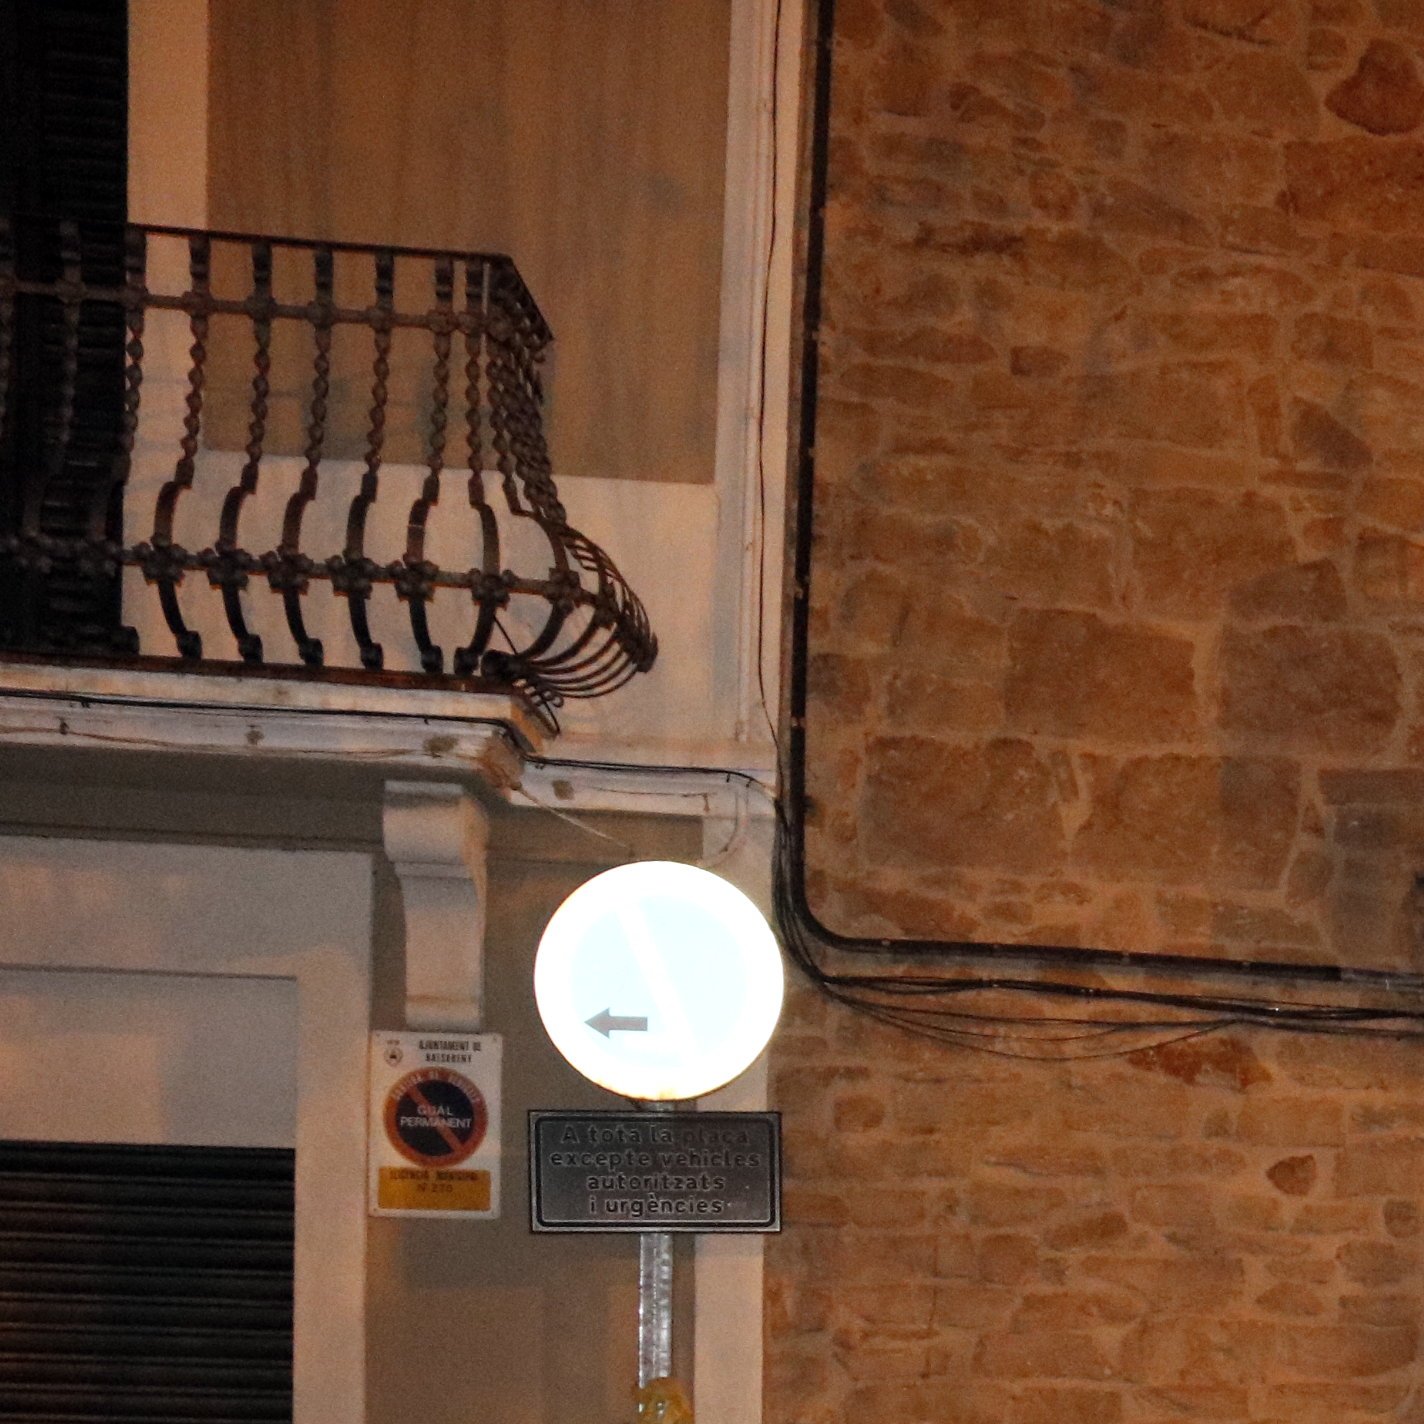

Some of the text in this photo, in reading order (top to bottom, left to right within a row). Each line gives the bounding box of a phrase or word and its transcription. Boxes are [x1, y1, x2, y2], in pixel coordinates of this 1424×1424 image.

[417, 1105, 453, 1116] GUAL
[400, 1116, 472, 1128] PERMANENT
[561, 1124, 750, 1148] A tota la plaça
[551, 1148, 761, 1172] excepte vehicles
[586, 1172, 726, 1192] autoritzats
[589, 1192, 724, 1217] i urgències
